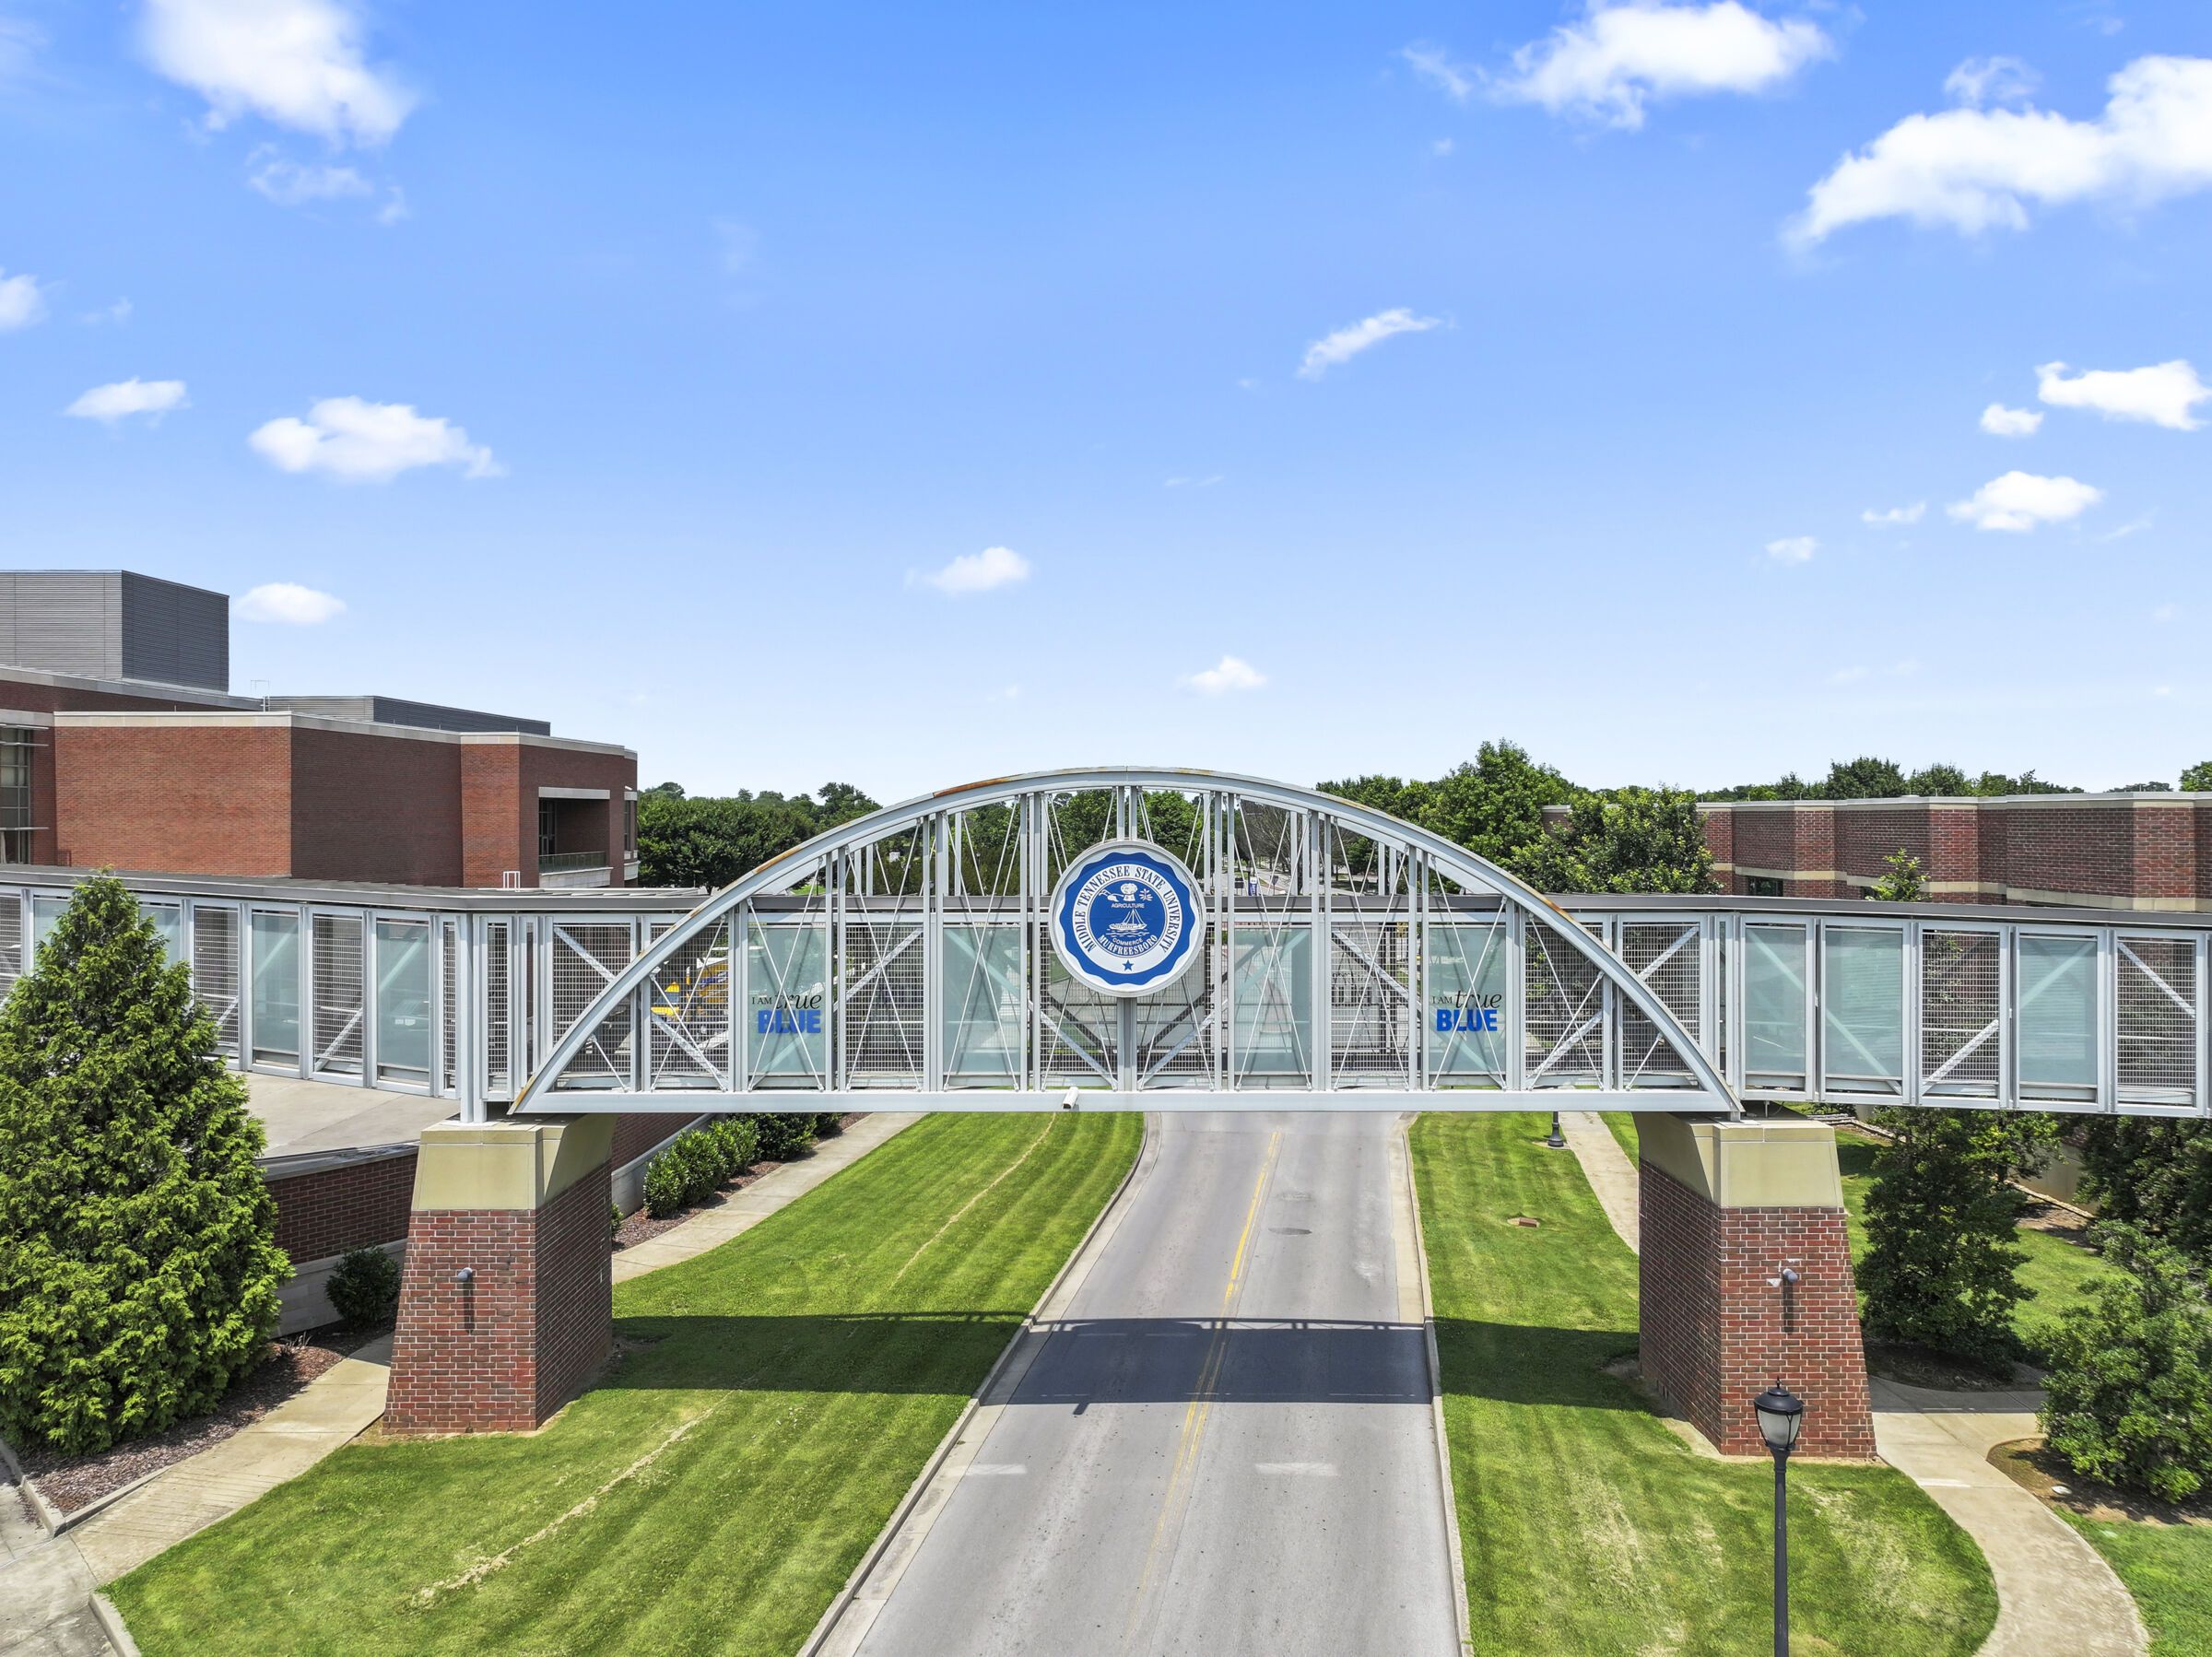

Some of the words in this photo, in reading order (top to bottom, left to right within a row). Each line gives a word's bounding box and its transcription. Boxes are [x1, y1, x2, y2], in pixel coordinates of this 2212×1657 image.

[1077, 865, 1130, 908] TENNESSEE
[1135, 866, 1166, 890] STATE
[1075, 911, 1097, 953] MIDDLE
[1159, 890, 1181, 953] UNIVERSITY
[1098, 934, 1158, 955] MURFREESBORO
[775, 991, 822, 1009] true
[1454, 990, 1502, 1008] true
[758, 1010, 821, 1033] BLUE
[1436, 1009, 1498, 1031] BLUE
